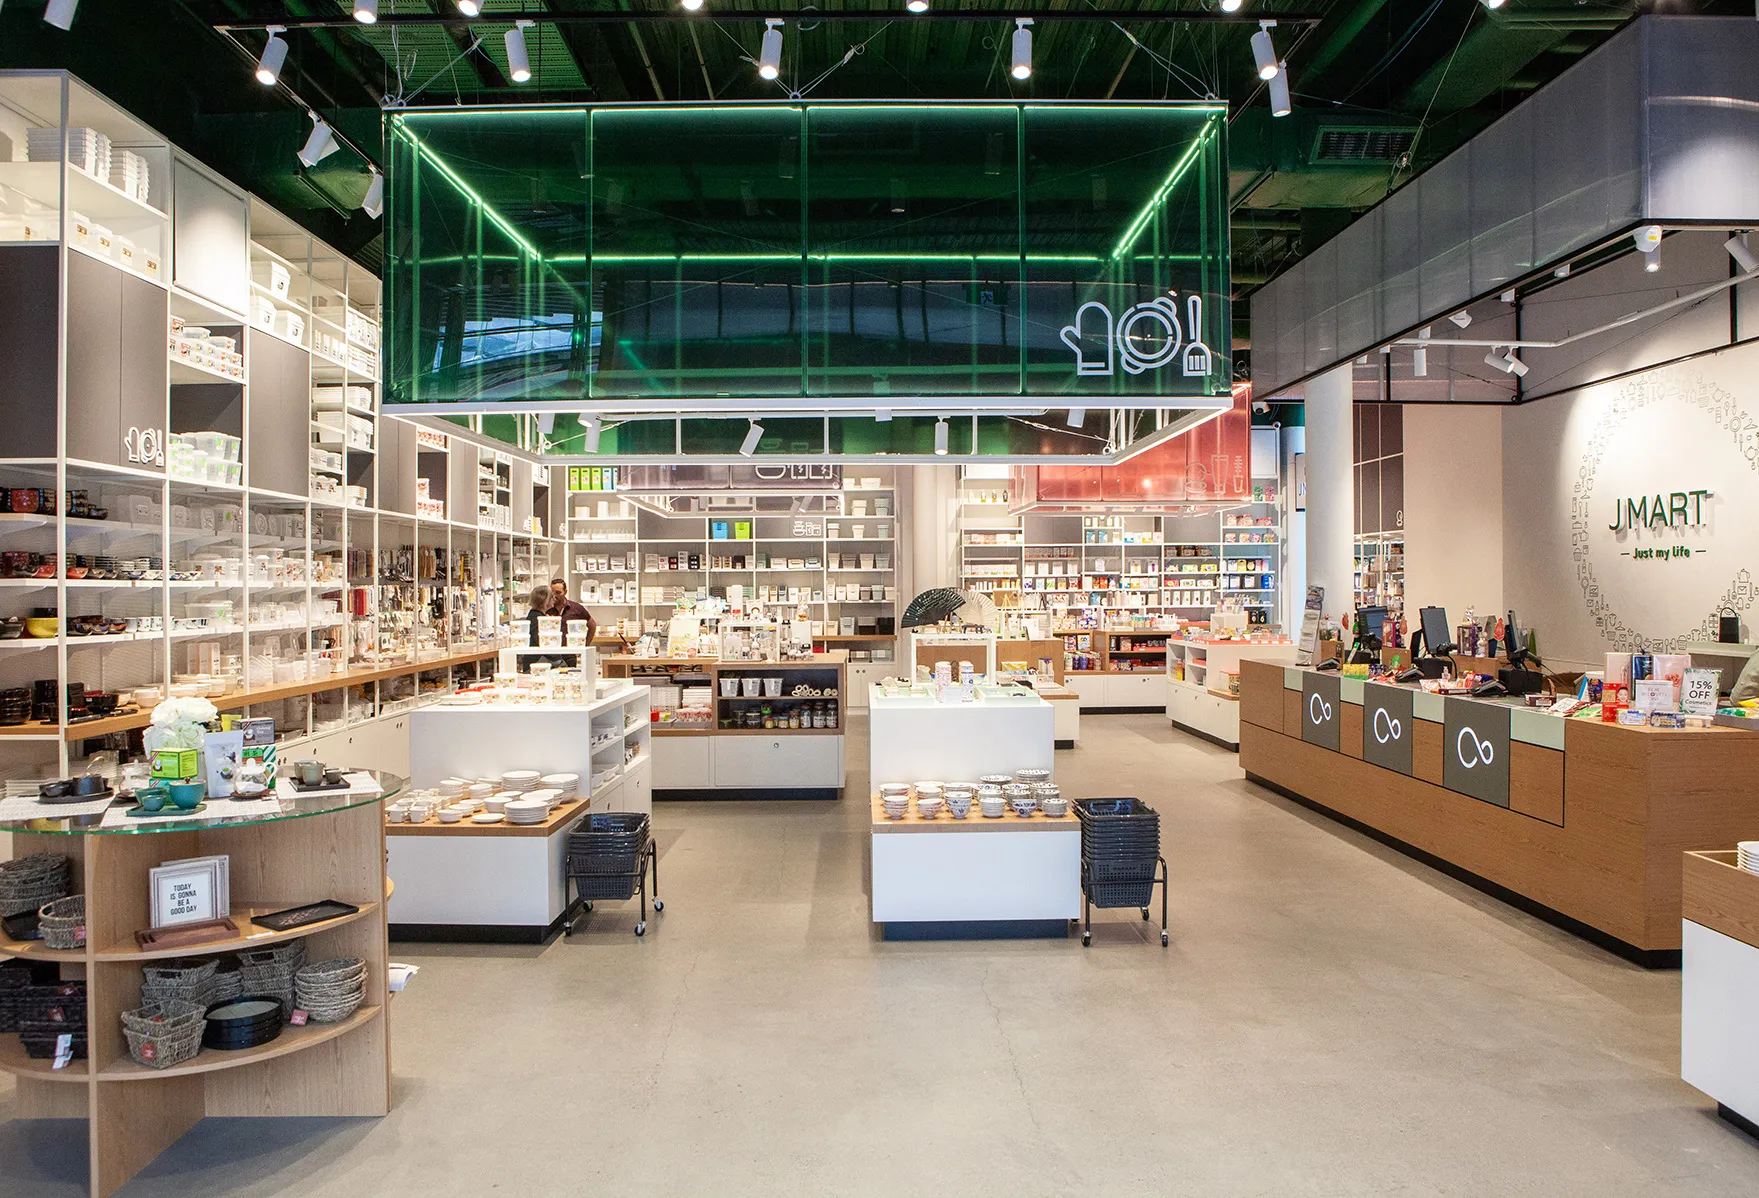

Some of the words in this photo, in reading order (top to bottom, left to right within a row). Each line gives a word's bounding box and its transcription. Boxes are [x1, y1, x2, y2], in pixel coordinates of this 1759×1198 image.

[1608, 489, 1708, 531] JMART
[1633, 547, 1654, 559] Just
[1655, 548, 1670, 561] my
[1672, 545, 1691, 558] life
[1690, 680, 1712, 690] 15%
[1689, 690, 1710, 699] OFF
[174, 883, 191, 891] TODAY
[170, 892, 176, 900] IS
[178, 890, 197, 898] GONNA
[170, 907, 185, 915] GOOD
